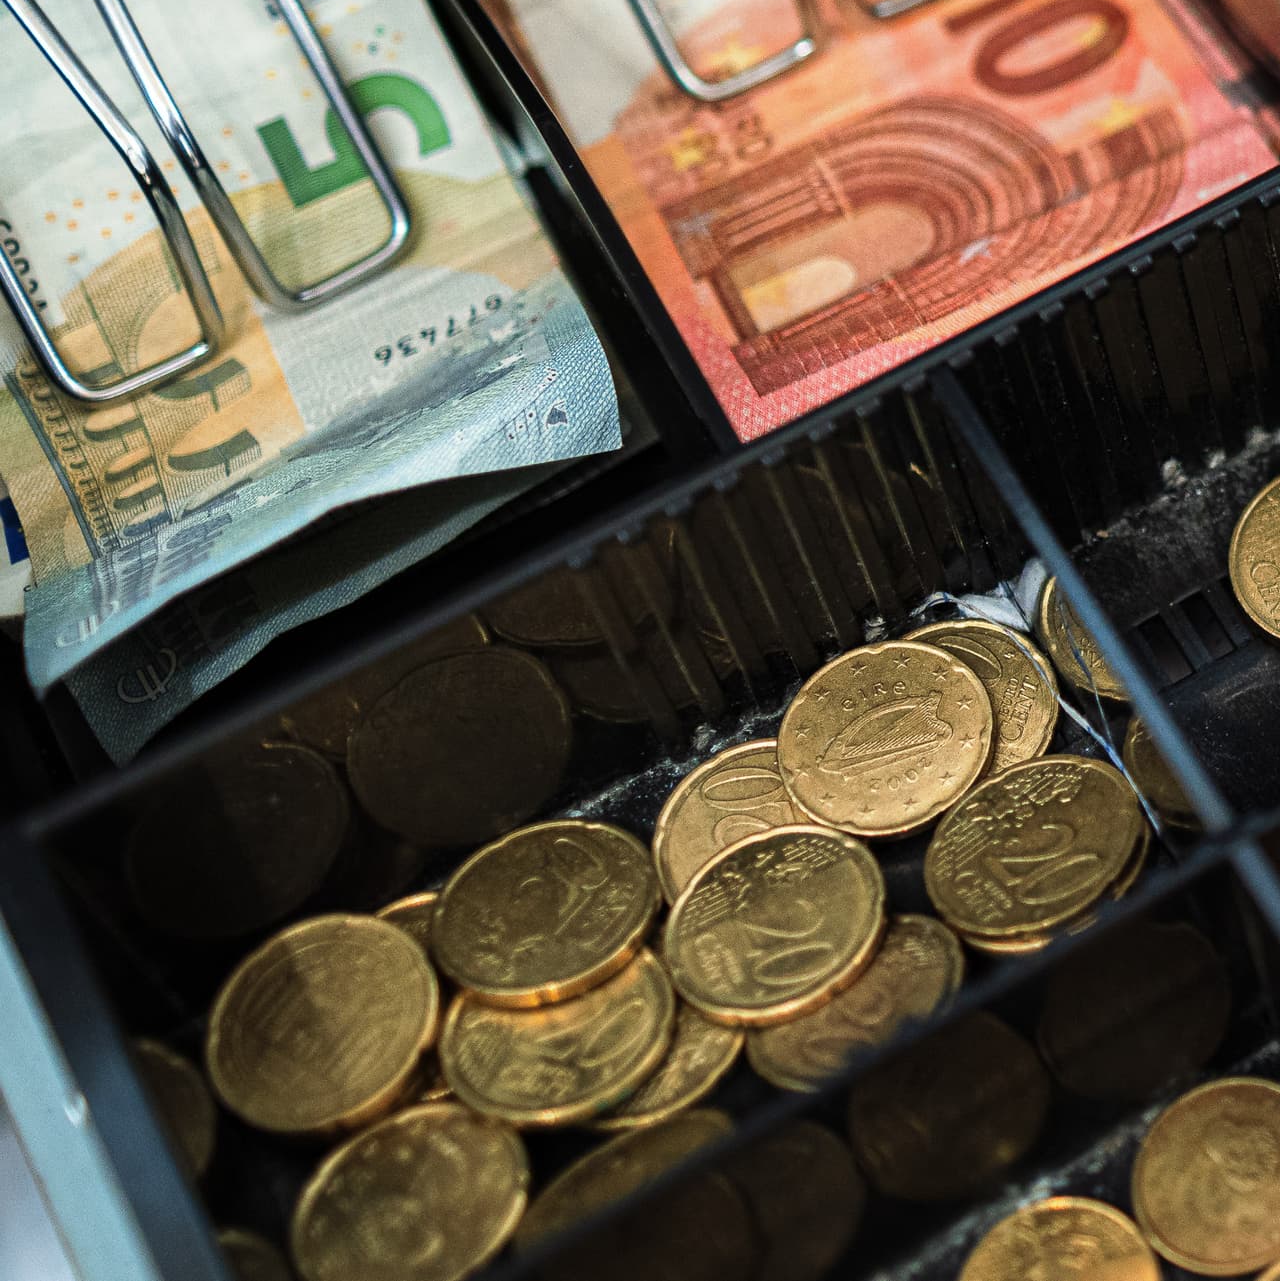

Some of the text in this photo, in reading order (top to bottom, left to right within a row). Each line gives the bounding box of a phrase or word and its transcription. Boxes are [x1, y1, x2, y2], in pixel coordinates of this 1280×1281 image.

[257, 71, 452, 208] 5
[999, 677, 1020, 718] EURO
[1002, 674, 1043, 746] CENT
[984, 820, 1102, 907] 20
